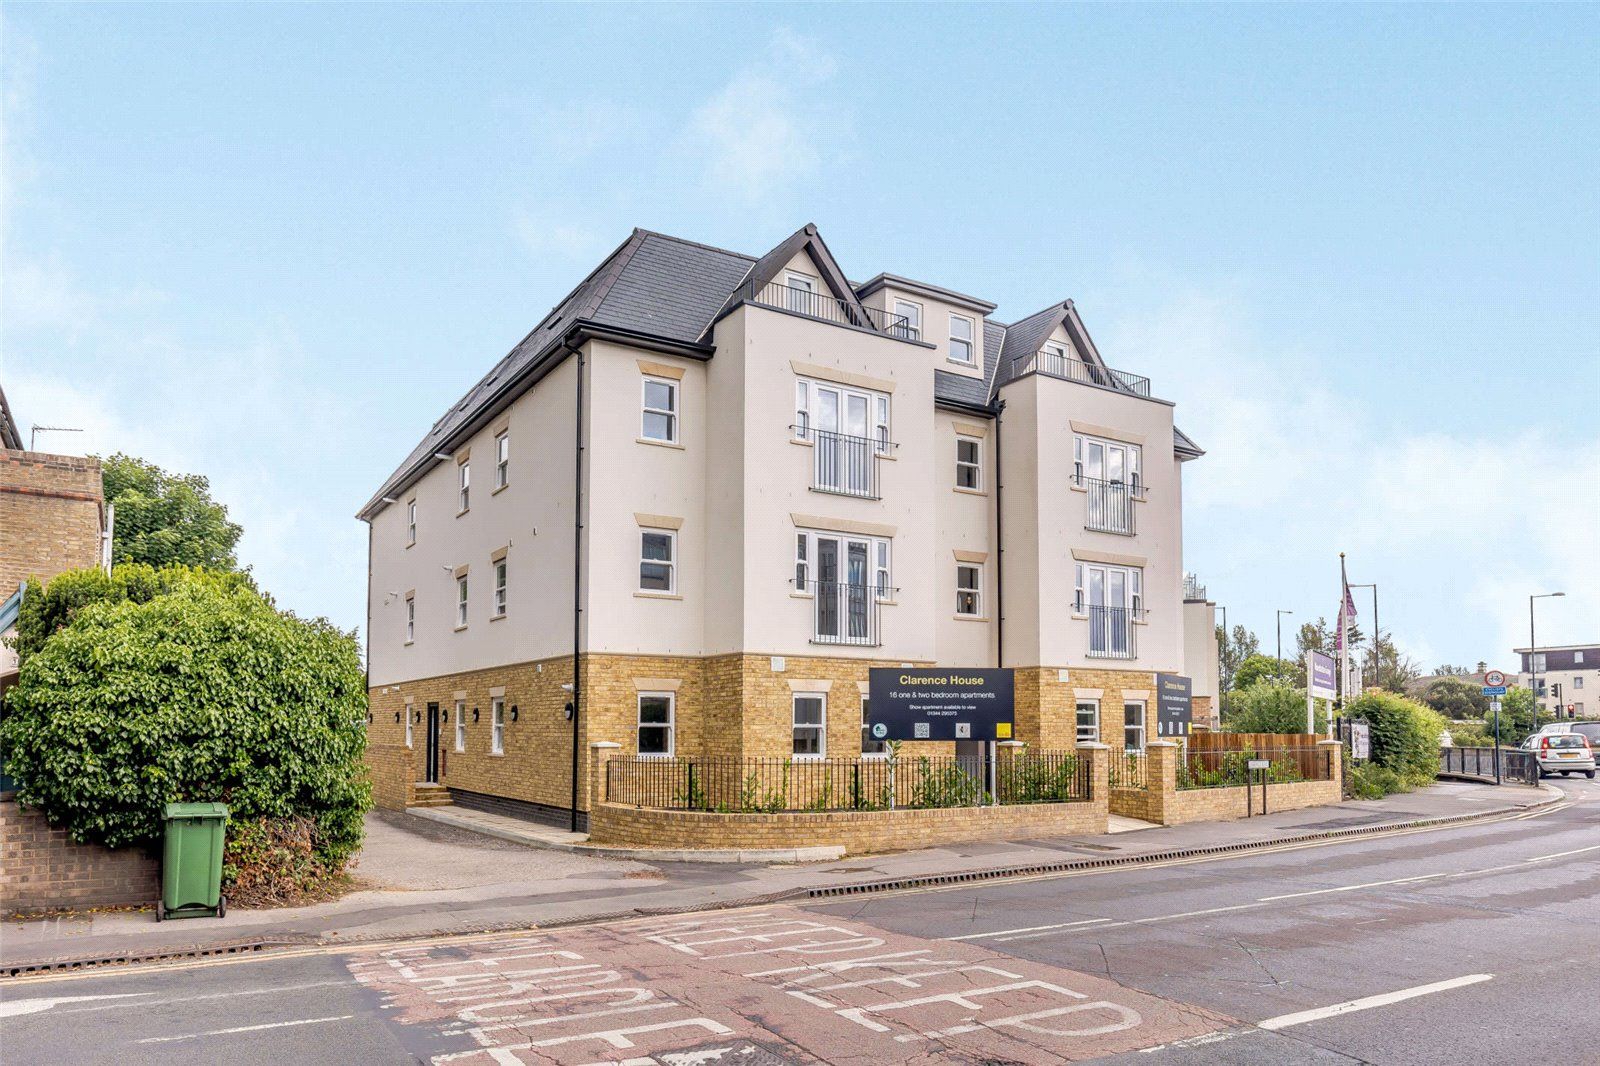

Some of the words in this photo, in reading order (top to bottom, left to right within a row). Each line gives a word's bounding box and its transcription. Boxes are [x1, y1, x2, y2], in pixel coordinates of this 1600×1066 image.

[899, 675, 947, 685] Clarence
[950, 675, 984, 685] House
[626, 914, 886, 961] KEEP
[745, 949, 1145, 1043] KEEP
